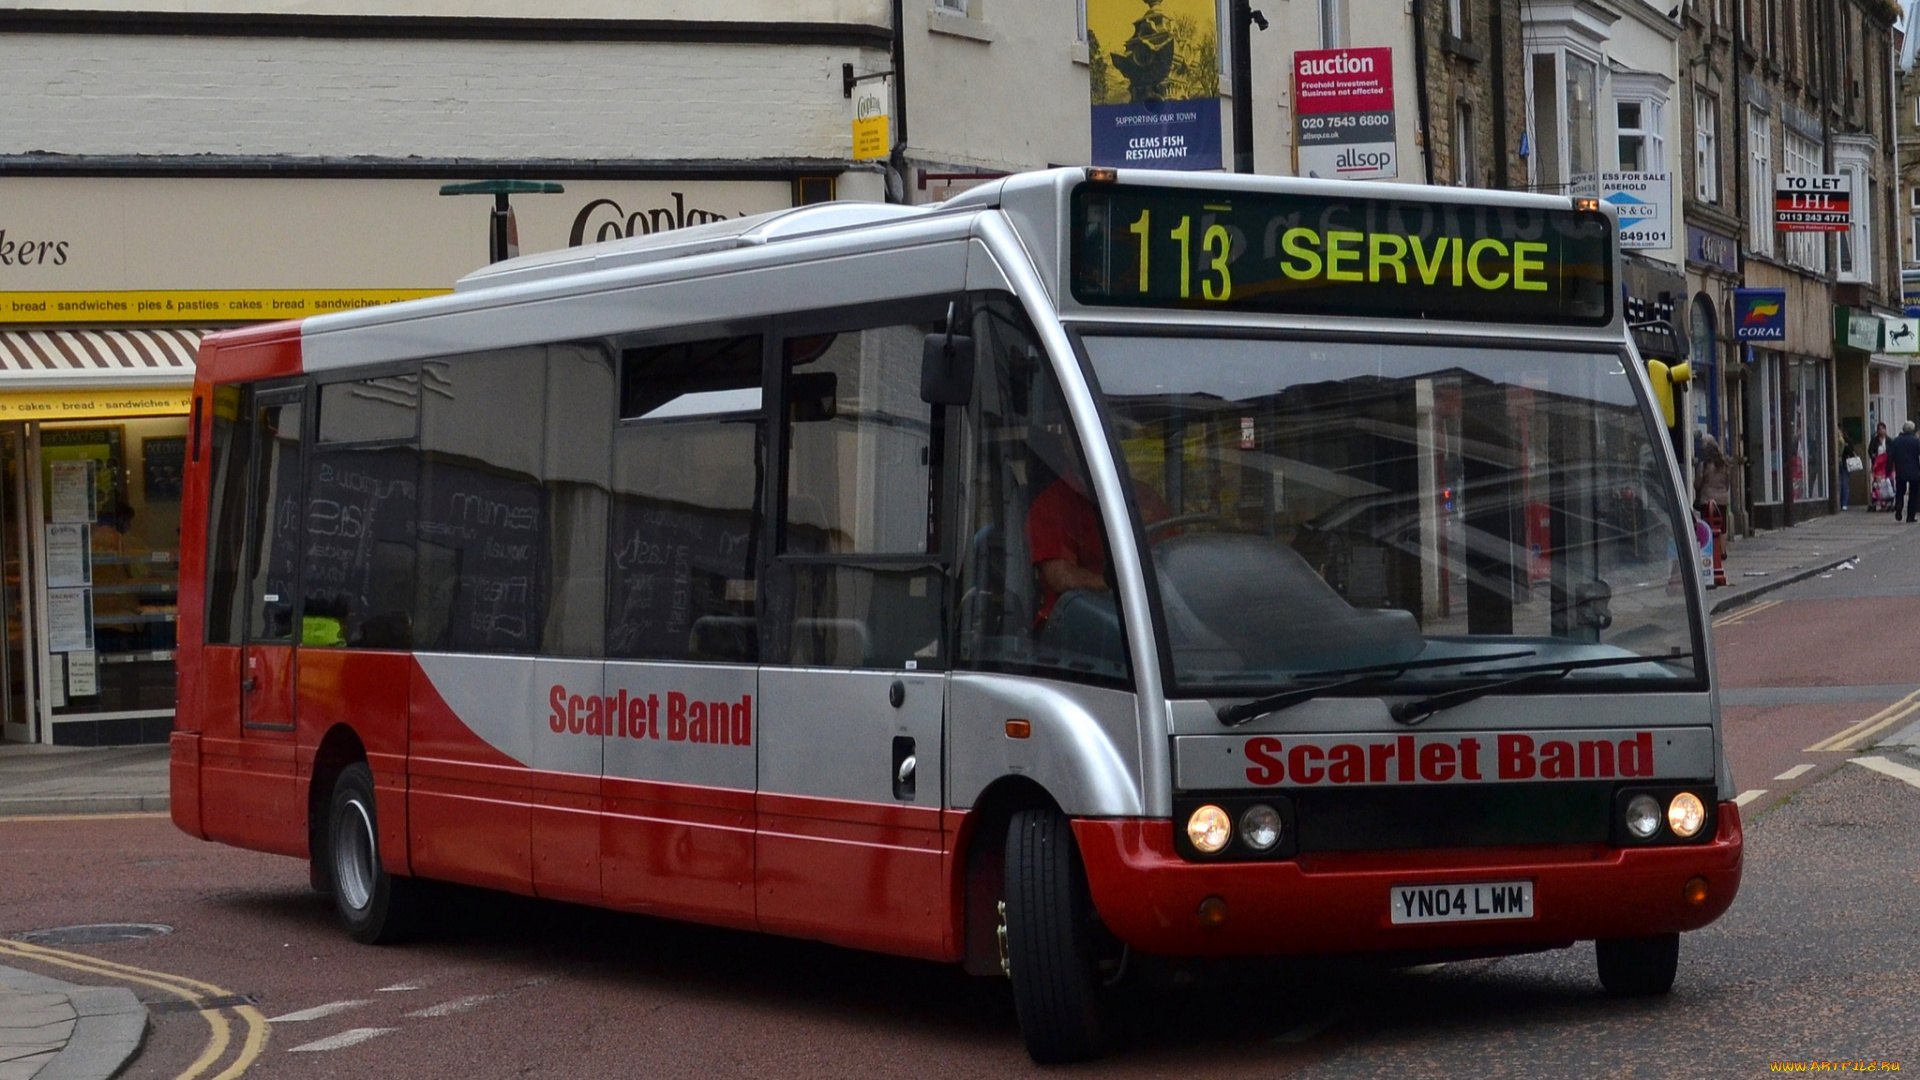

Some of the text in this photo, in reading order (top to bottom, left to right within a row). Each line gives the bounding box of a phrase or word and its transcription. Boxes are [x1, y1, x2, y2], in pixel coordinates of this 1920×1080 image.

[1300, 53, 1374, 76] auction
[1302, 90, 1336, 98] Business
[1115, 112, 1197, 126] SUPPORTING OUR TOWN
[1302, 114, 1389, 129] 020 7543 6800
[1129, 135, 1184, 149] CLEMS FISH
[1302, 131, 1339, 141] allsop.co.uk
[1126, 146, 1188, 161] RESTAURANT
[1336, 148, 1390, 170] allsop
[1602, 183, 1647, 191] ASEHOLD
[1786, 177, 1841, 190] TO LET
[1791, 193, 1835, 210] LHL
[1629, 206, 1637, 215] &
[1640, 206, 1653, 215] Co
[1780, 213, 1846, 222] 0113 243 4771
[1620, 232, 1666, 241] 849101
[1280, 227, 1549, 291] SERVICE
[12, 301, 46, 312] bread
[58, 300, 128, 311] sandwiches
[138, 300, 162, 313] pies
[166, 300, 174, 310] &
[178, 299, 220, 313] pasties
[230, 299, 262, 310] cakes
[272, 299, 305, 310] bread
[1738, 327, 1782, 337] CORAL
[18, 402, 52, 411] cakes
[62, 401, 95, 410] bread
[105, 399, 170, 410] sandwiches
[548, 684, 752, 747] Scarlet Band
[1243, 732, 1655, 786] Scarlet Band
[1401, 884, 1524, 917] YN04 LWM
